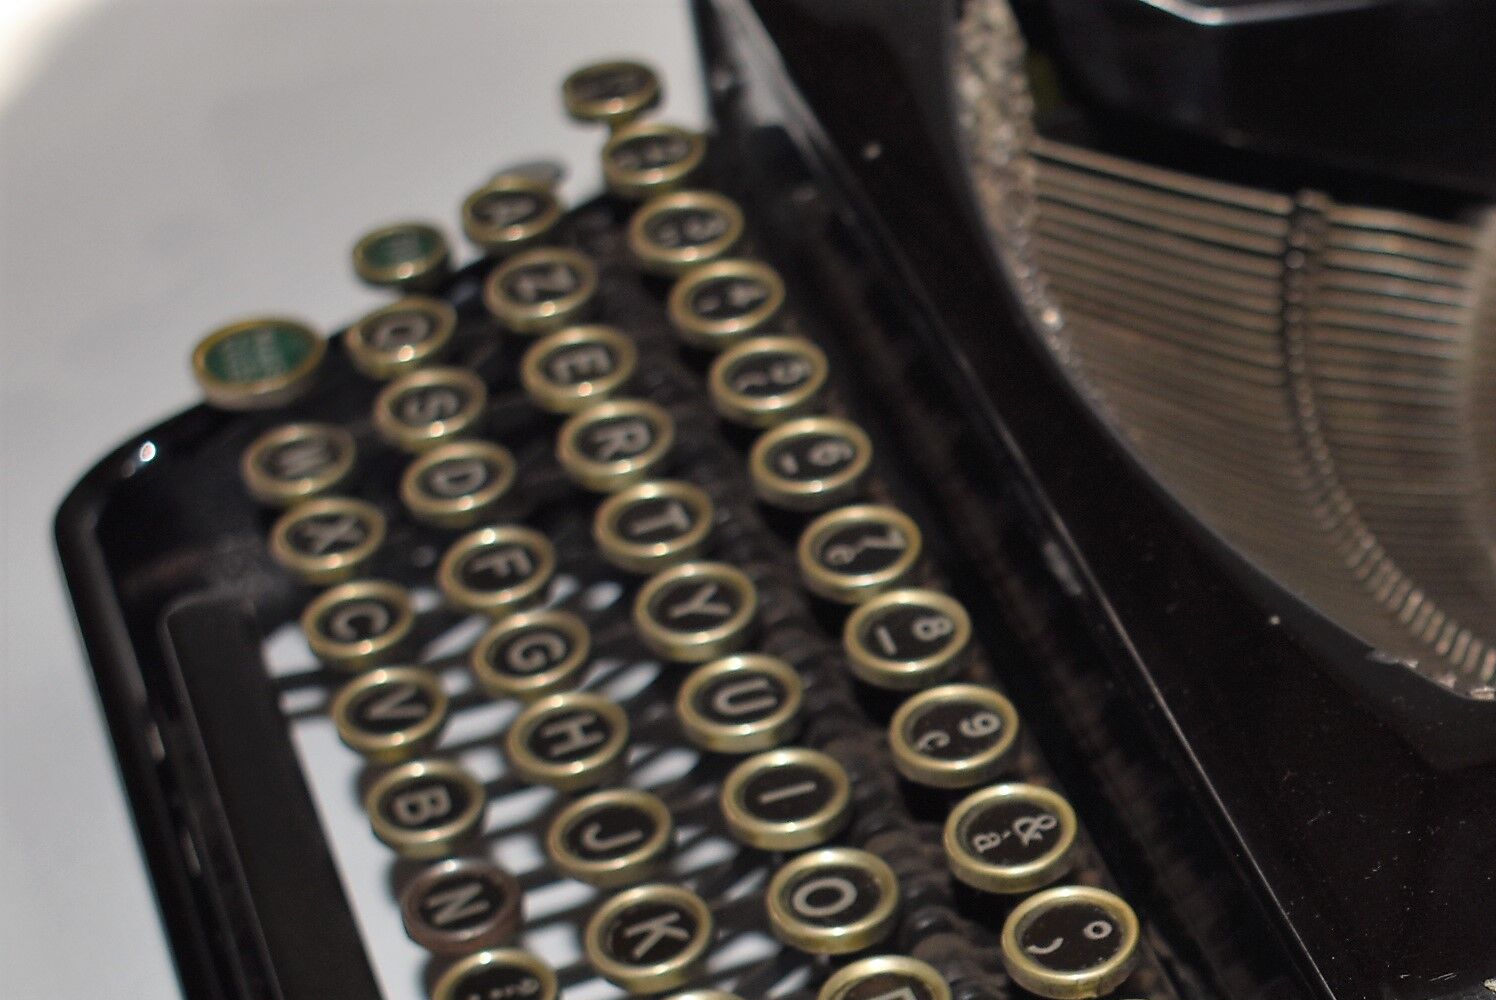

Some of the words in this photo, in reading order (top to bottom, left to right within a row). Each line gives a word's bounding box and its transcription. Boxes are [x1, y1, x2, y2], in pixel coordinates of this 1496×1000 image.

[515, 262, 576, 298] Z
[550, 348, 611, 384] E
[404, 389, 460, 421] S
[594, 421, 650, 459] R
[430, 458, 488, 495] D
[302, 516, 364, 556] X
[632, 503, 690, 536] T
[854, 529, 908, 551] 7
[470, 548, 533, 579] F
[669, 584, 731, 618] Y
[329, 602, 389, 642] C
[913, 616, 955, 640] 8
[506, 632, 567, 671] G
[365, 686, 427, 721] V
[714, 678, 777, 716] U
[542, 713, 606, 757] H
[958, 711, 1000, 739] 9
[394, 786, 452, 825] B
[759, 781, 817, 805] I
[582, 821, 644, 852] J
[971, 828, 1012, 855] à
[1013, 813, 1058, 847] &
[426, 881, 491, 926] N
[793, 878, 858, 918] O
[624, 911, 689, 958] K
